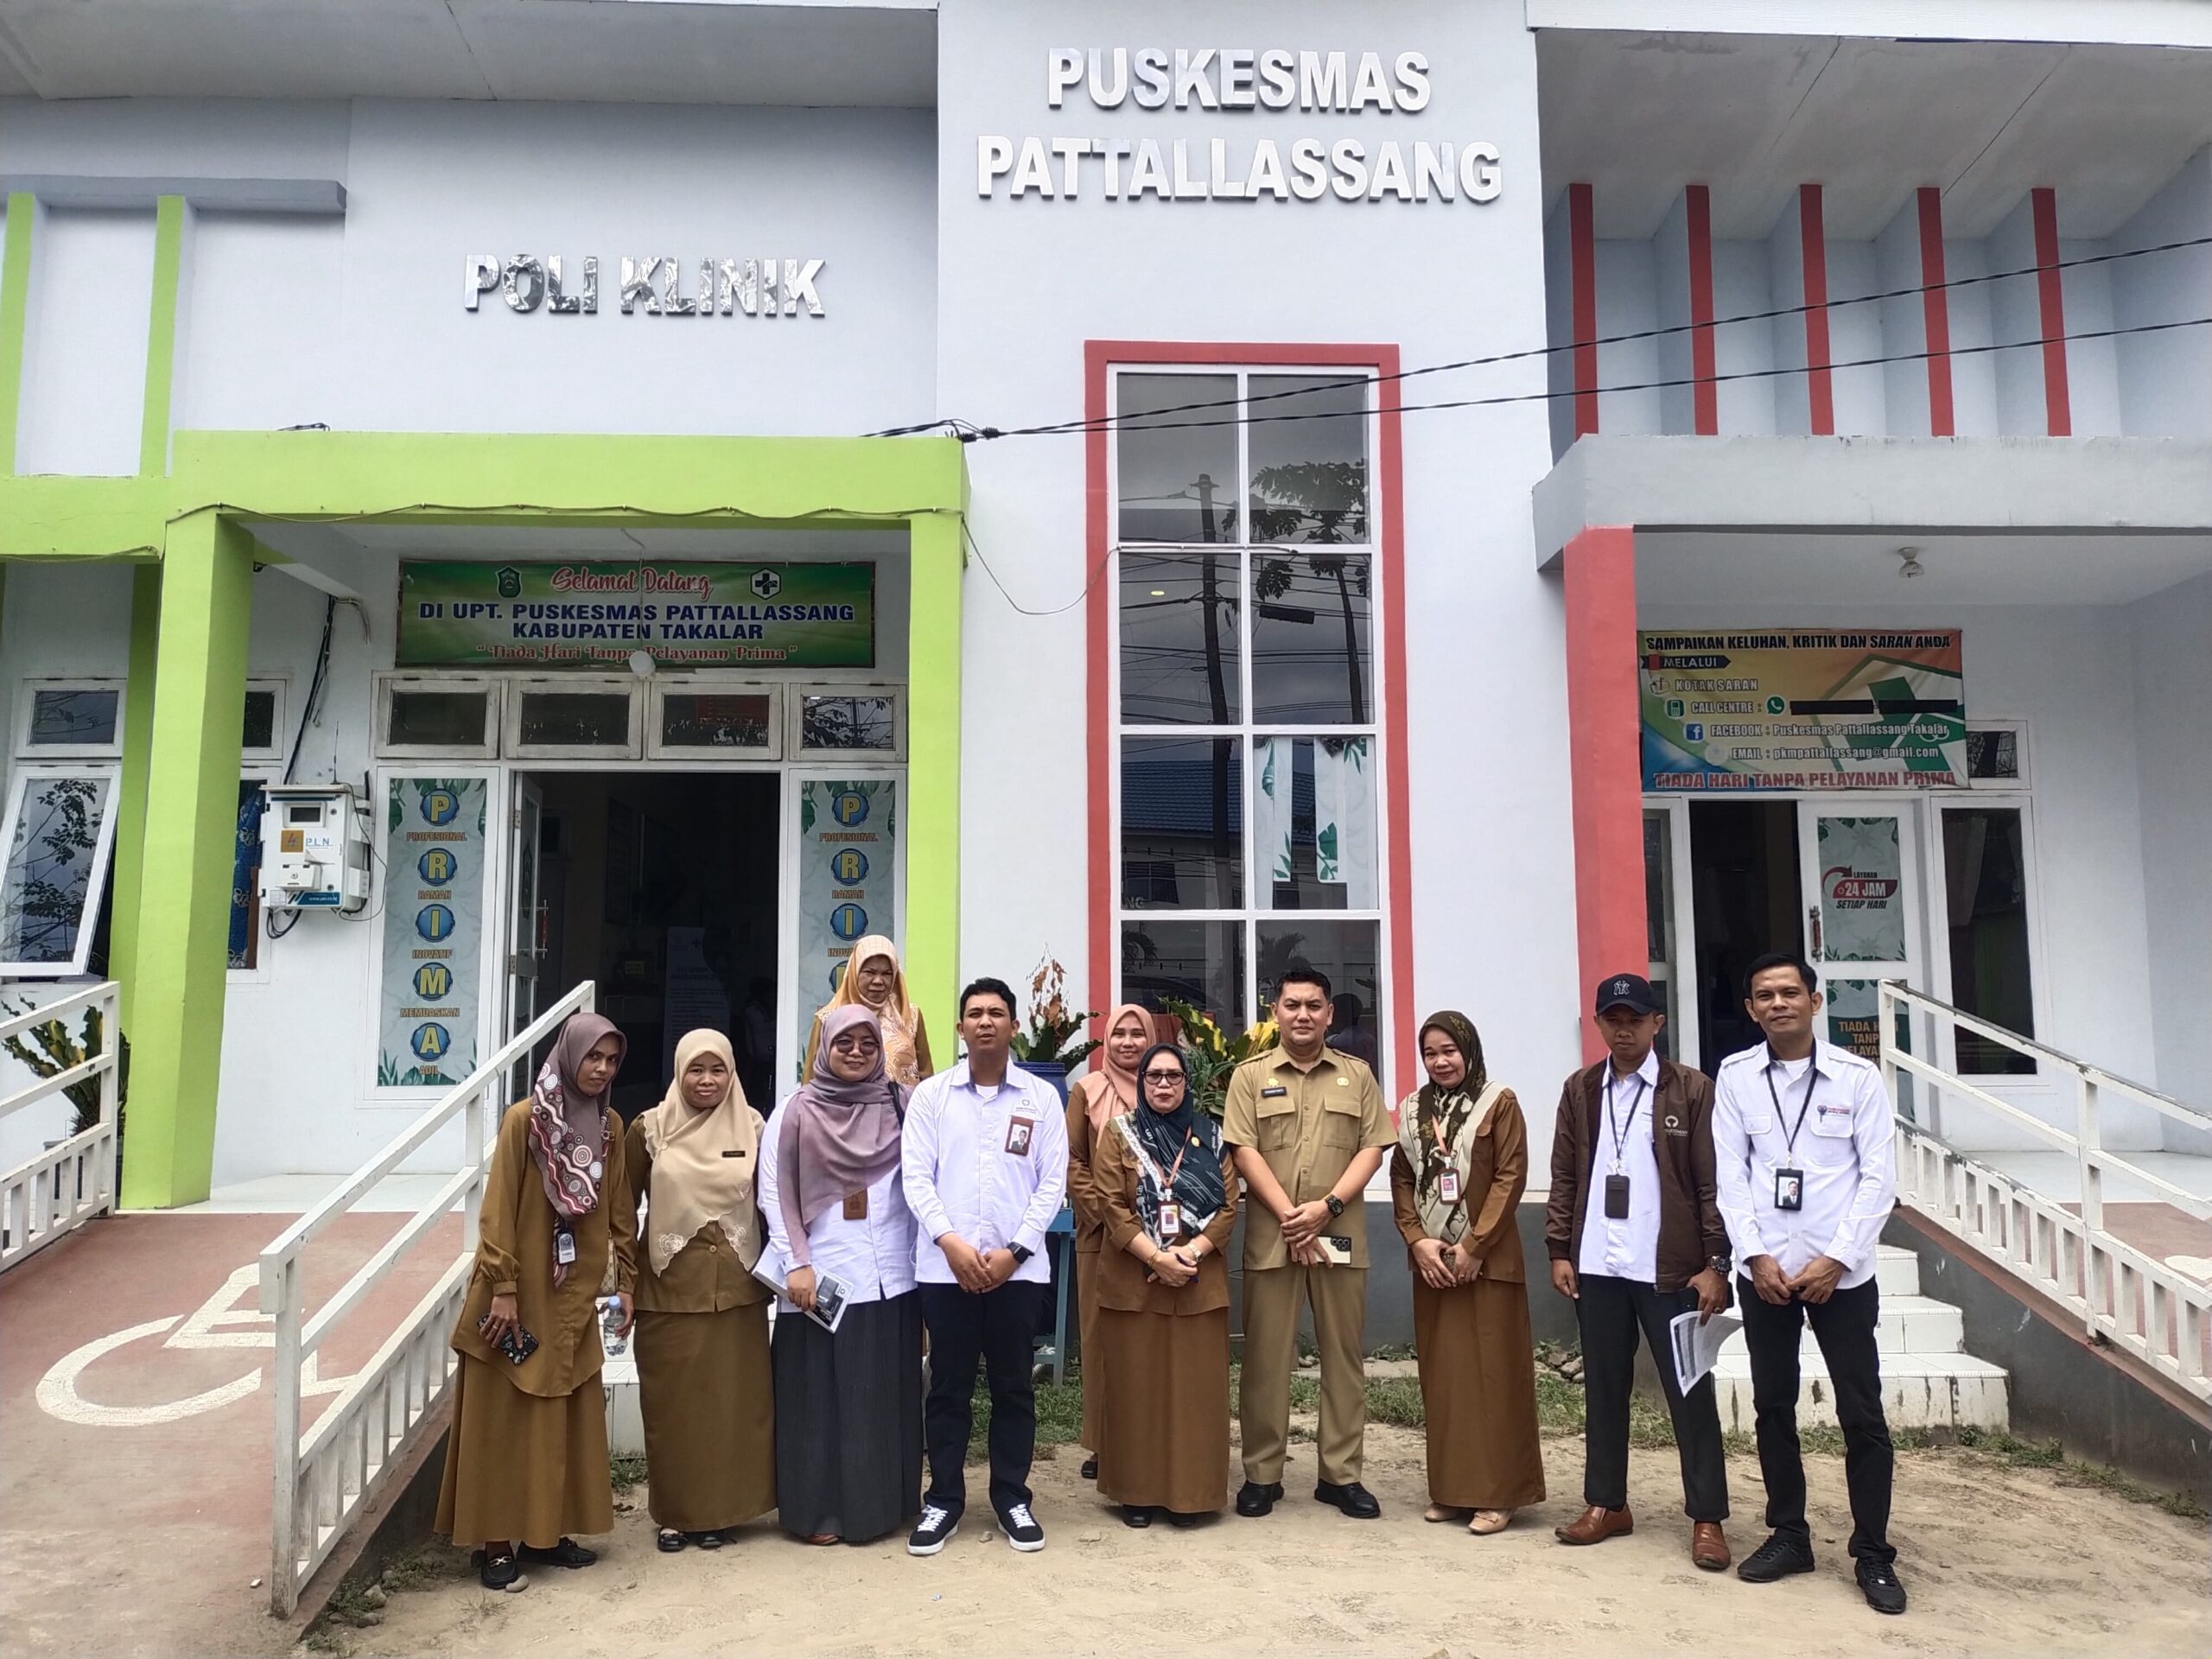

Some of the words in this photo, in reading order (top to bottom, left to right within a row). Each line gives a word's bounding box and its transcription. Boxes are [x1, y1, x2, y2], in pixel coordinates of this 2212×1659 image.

[1047, 48, 1432, 113] PUSKESMAS
[977, 136, 1503, 203] PATTALLASSANG
[464, 253, 599, 314] POLI
[620, 256, 827, 317] KLINIK
[551, 567, 639, 593] Selamat
[419, 603, 442, 619] DI
[453, 603, 503, 619] UPT.
[512, 604, 658, 620] PUSKESMAS
[666, 605, 854, 621] PATTALLASSANG
[512, 623, 651, 639] KABUPATEN
[659, 624, 764, 639] TAKALAR
[1646, 637, 1724, 650] SAMPAIKAN
[1727, 635, 1789, 649] KELUHAN,
[1792, 635, 1837, 648] KRITIK
[1840, 635, 1866, 648] DAN
[1870, 635, 1913, 648] SARAN
[1916, 635, 1950, 647] ANDA
[537, 642, 581, 662] Hari
[732, 645, 787, 660] Prima
[1663, 657, 1717, 667] MELALUI
[1675, 679, 1715, 691] KOTAK
[1717, 679, 1758, 691] SARAN
[1691, 702, 1715, 713] CALL
[1716, 702, 1753, 713] CENTRE
[1711, 724, 1763, 736] FACEBOOK
[1773, 724, 1834, 736] Puskesmas
[1835, 723, 1907, 736] Pattallassang
[1909, 723, 1948, 734] Takalar
[1732, 748, 1762, 760] EMAIL
[1655, 773, 1706, 788] TIADA
[1707, 772, 1750, 788] HARI
[1752, 772, 1805, 787] TANPA
[1808, 772, 1899, 787] PELAYANAN
[1903, 772, 1956, 786] PRIMA
[406, 832, 467, 841] PROFESIONAL
[819, 833, 878, 842] PROFESIONAL
[418, 890, 451, 899] RAMAH
[832, 890, 864, 899] RAMAH
[1845, 881, 1859, 897] 24
[1862, 881, 1886, 897] JAM
[1836, 899, 1866, 909] SETIAP
[1866, 899, 1887, 909] HARI
[412, 949, 452, 959] INOVATIF
[400, 1007, 461, 1017] MEMUASKAN
[1838, 1021, 1870, 1032] TIADA
[1853, 1033, 1879, 1044] TANP
[418, 1065, 440, 1075] ADIL
